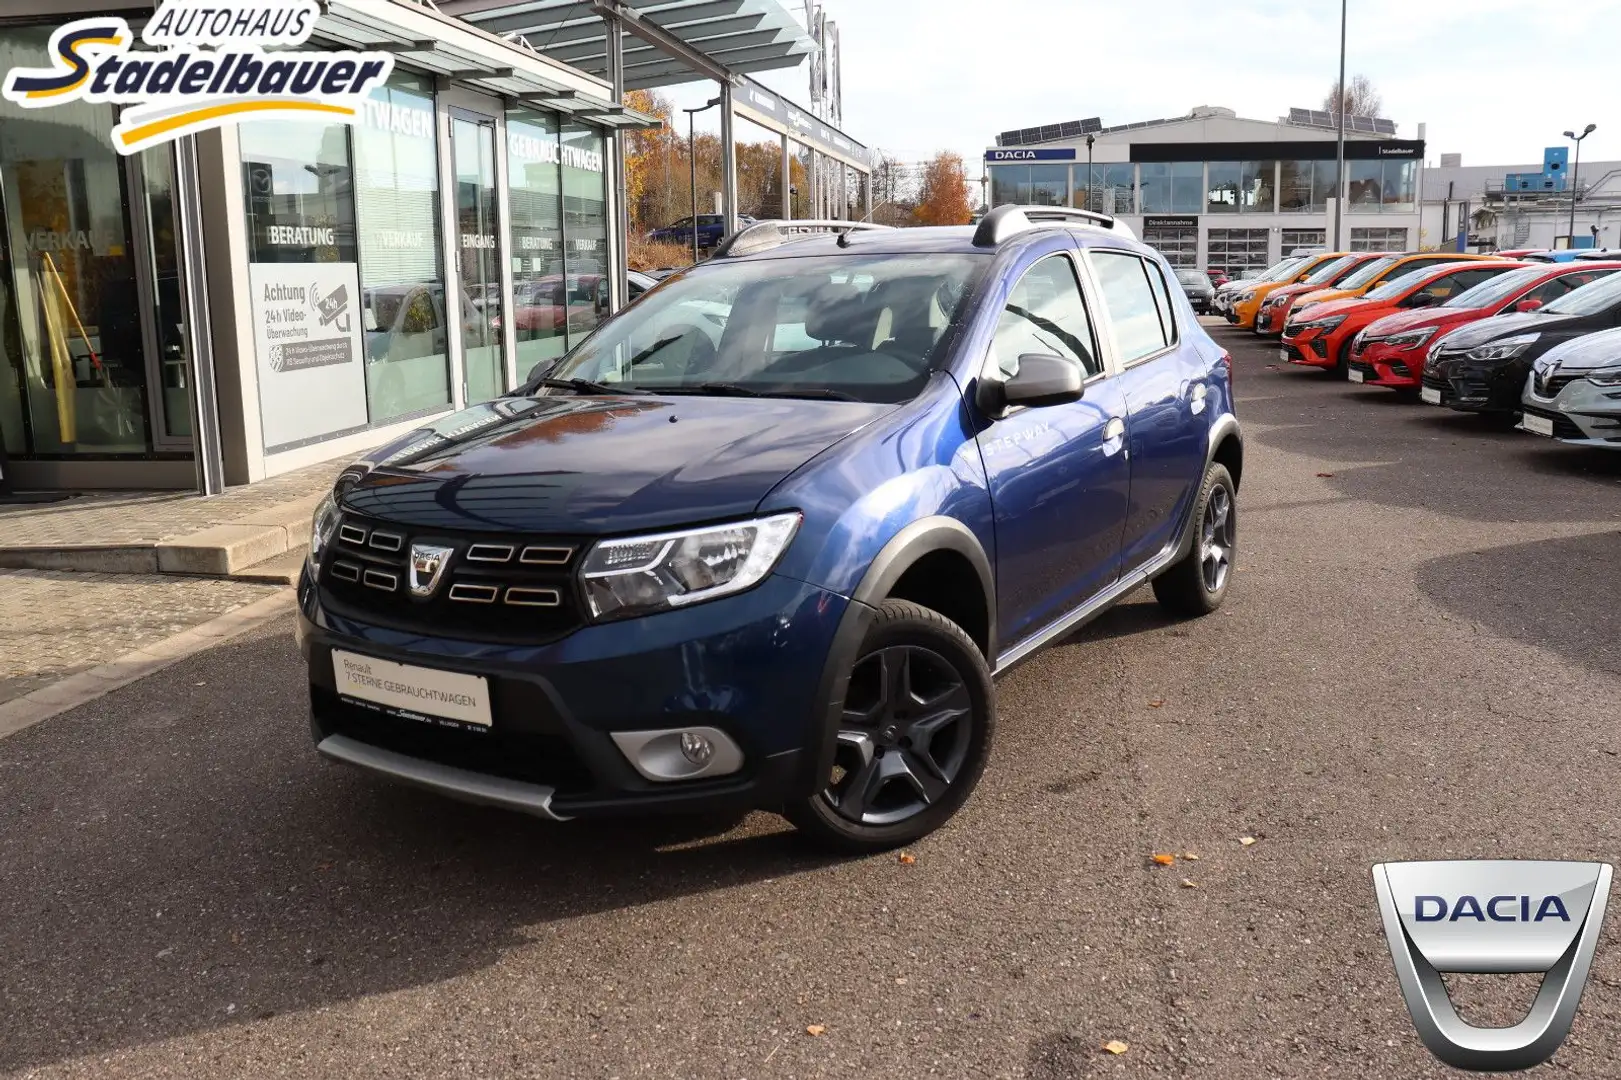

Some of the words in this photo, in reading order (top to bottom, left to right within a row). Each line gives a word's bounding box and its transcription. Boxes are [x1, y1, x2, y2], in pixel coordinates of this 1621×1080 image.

[509, 133, 602, 173] GEBRAUCHTWAGEN
[994, 150, 1036, 159] DACIA
[270, 226, 334, 246] BERATUNG
[382, 230, 423, 249] VERKAUF
[462, 234, 495, 249] EINGANG
[521, 236, 553, 250] BERATUNG
[576, 239, 597, 251] VERKAUF
[264, 283, 306, 304] Achtung
[325, 297, 338, 310] 24h
[283, 308, 307, 322] Video-
[266, 325, 308, 339] Überwachung
[984, 421, 1049, 457] STEPWAY
[415, 552, 440, 561] DACIA
[343, 659, 372, 675] Renault
[352, 672, 383, 689] STERNE
[384, 680, 477, 708] GEBRAUCHTWAGEN
